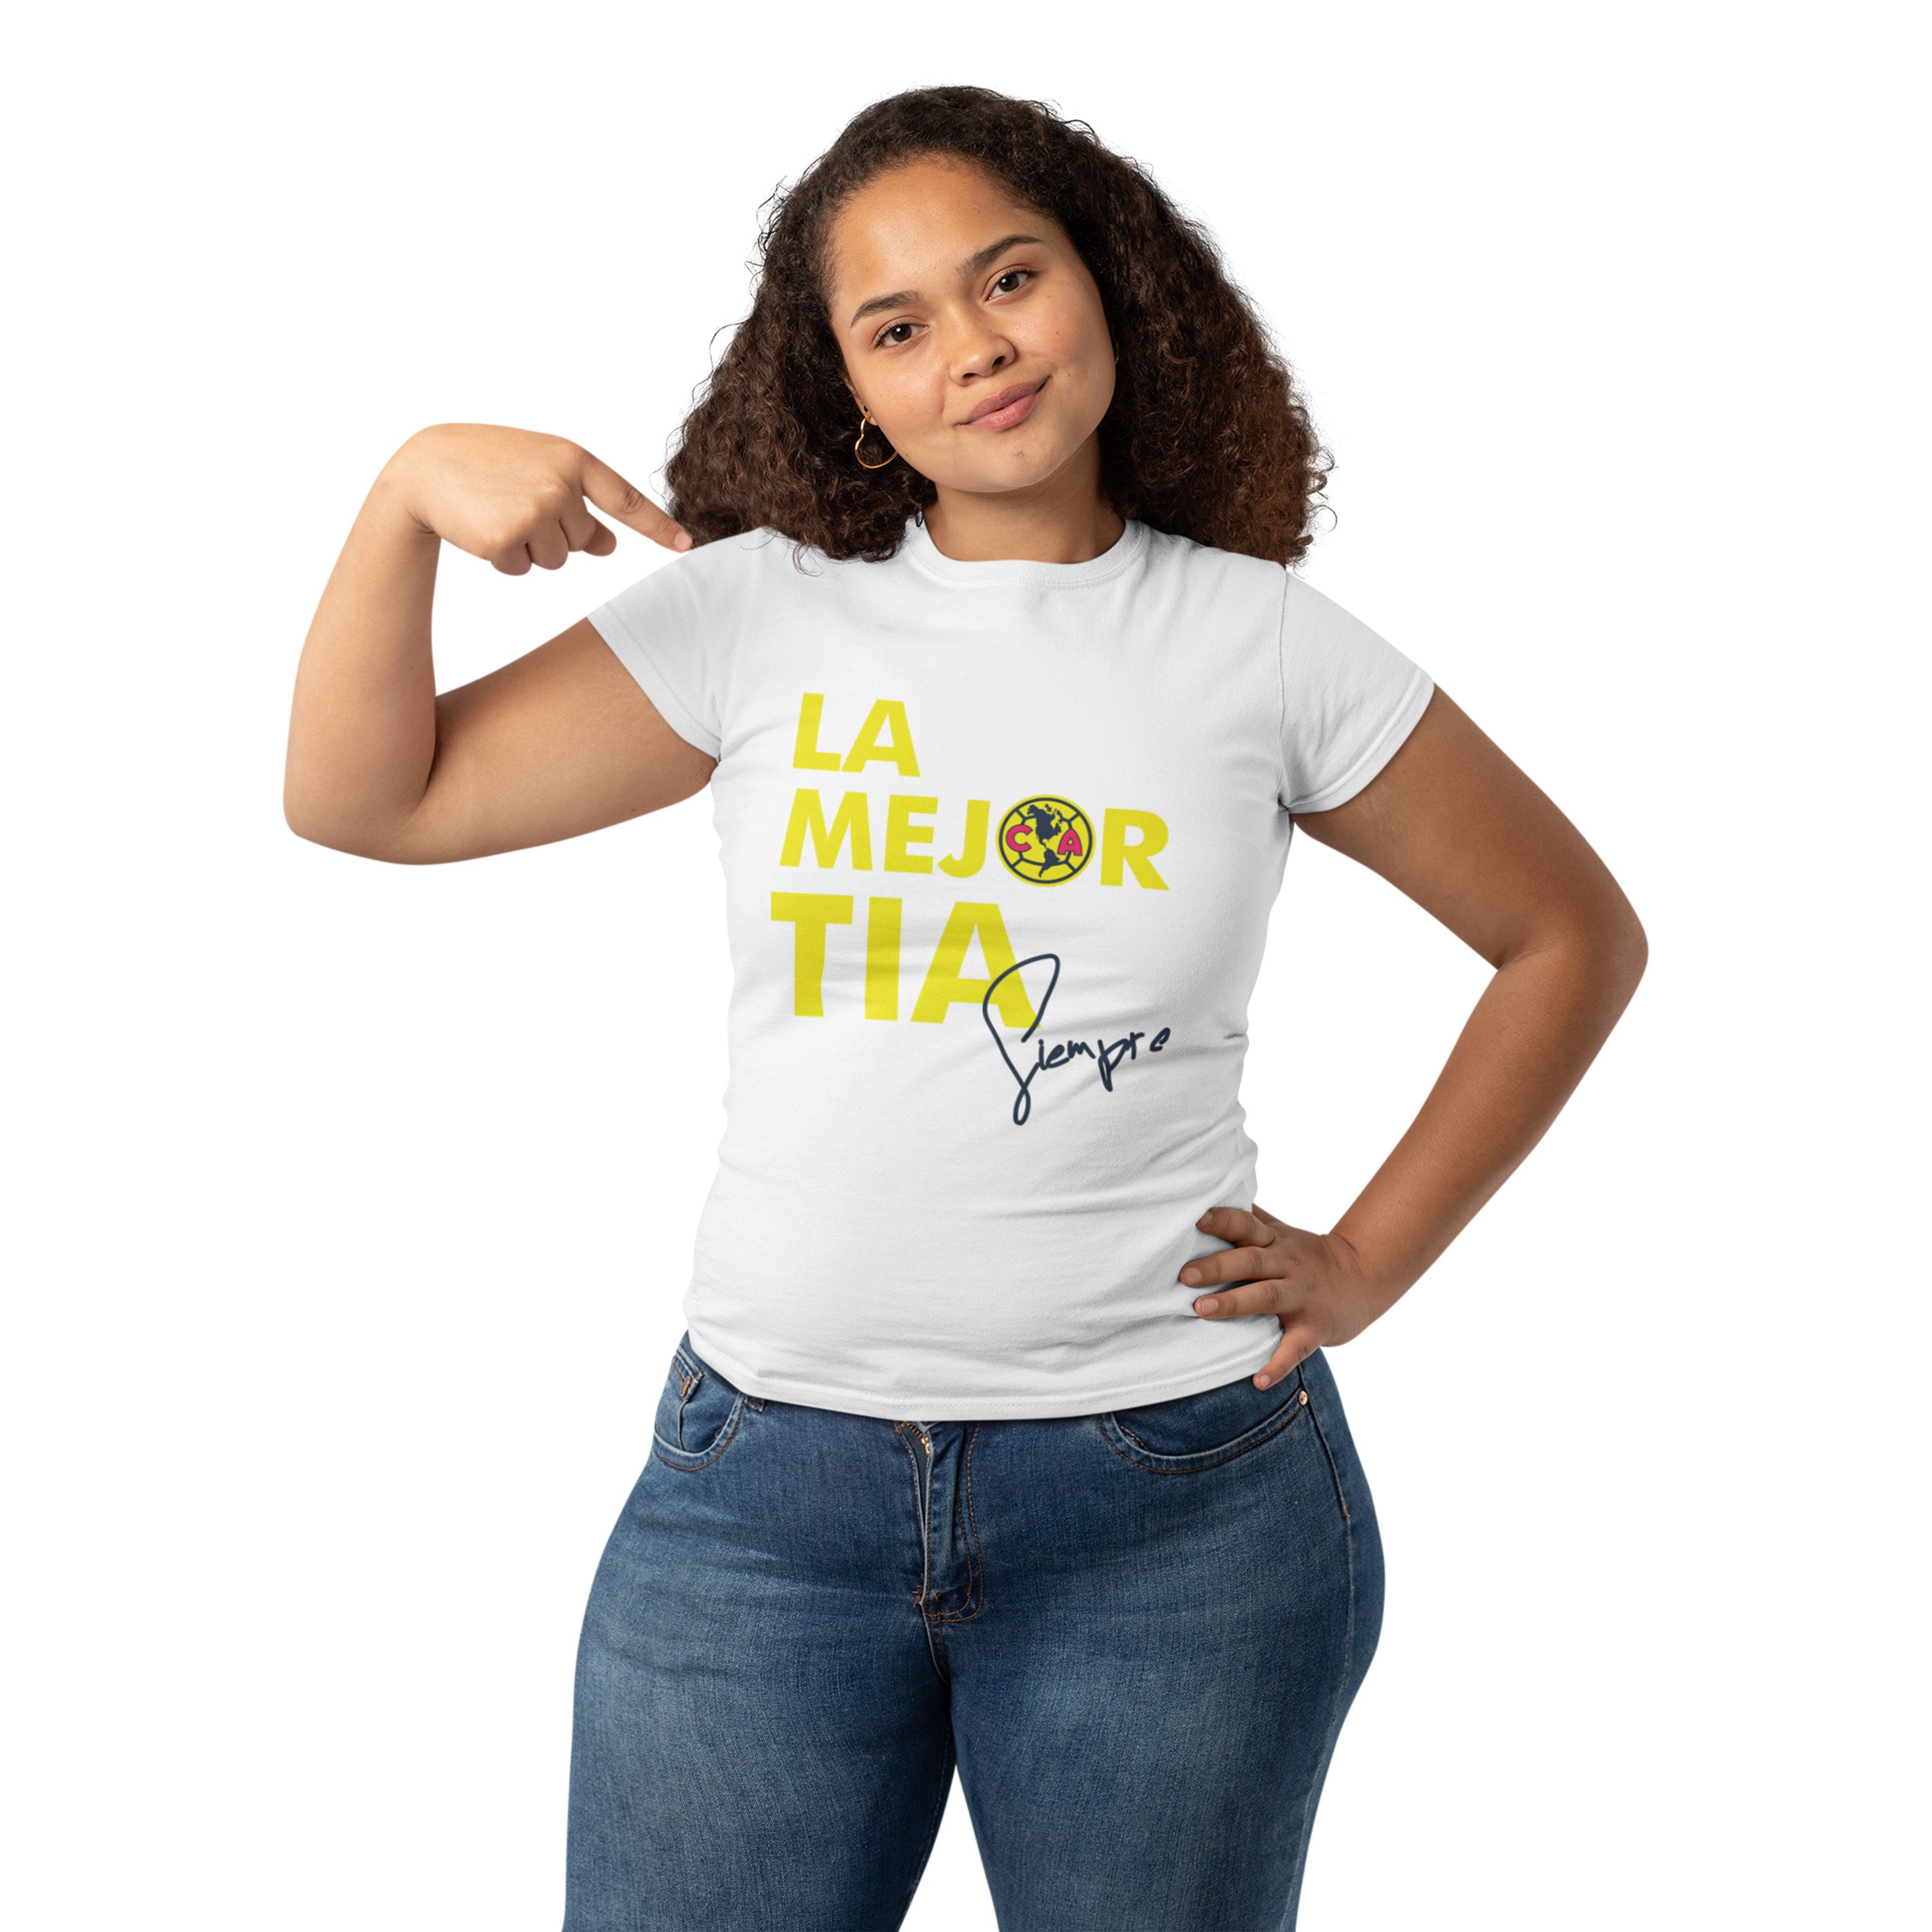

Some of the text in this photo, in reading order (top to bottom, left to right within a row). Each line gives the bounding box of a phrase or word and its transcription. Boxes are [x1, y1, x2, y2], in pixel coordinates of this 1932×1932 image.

[792, 692, 922, 777] LA
[779, 788, 1170, 891] MEJOR
[770, 891, 1042, 1029] TIA
[982, 954, 1171, 1126] Siempre
